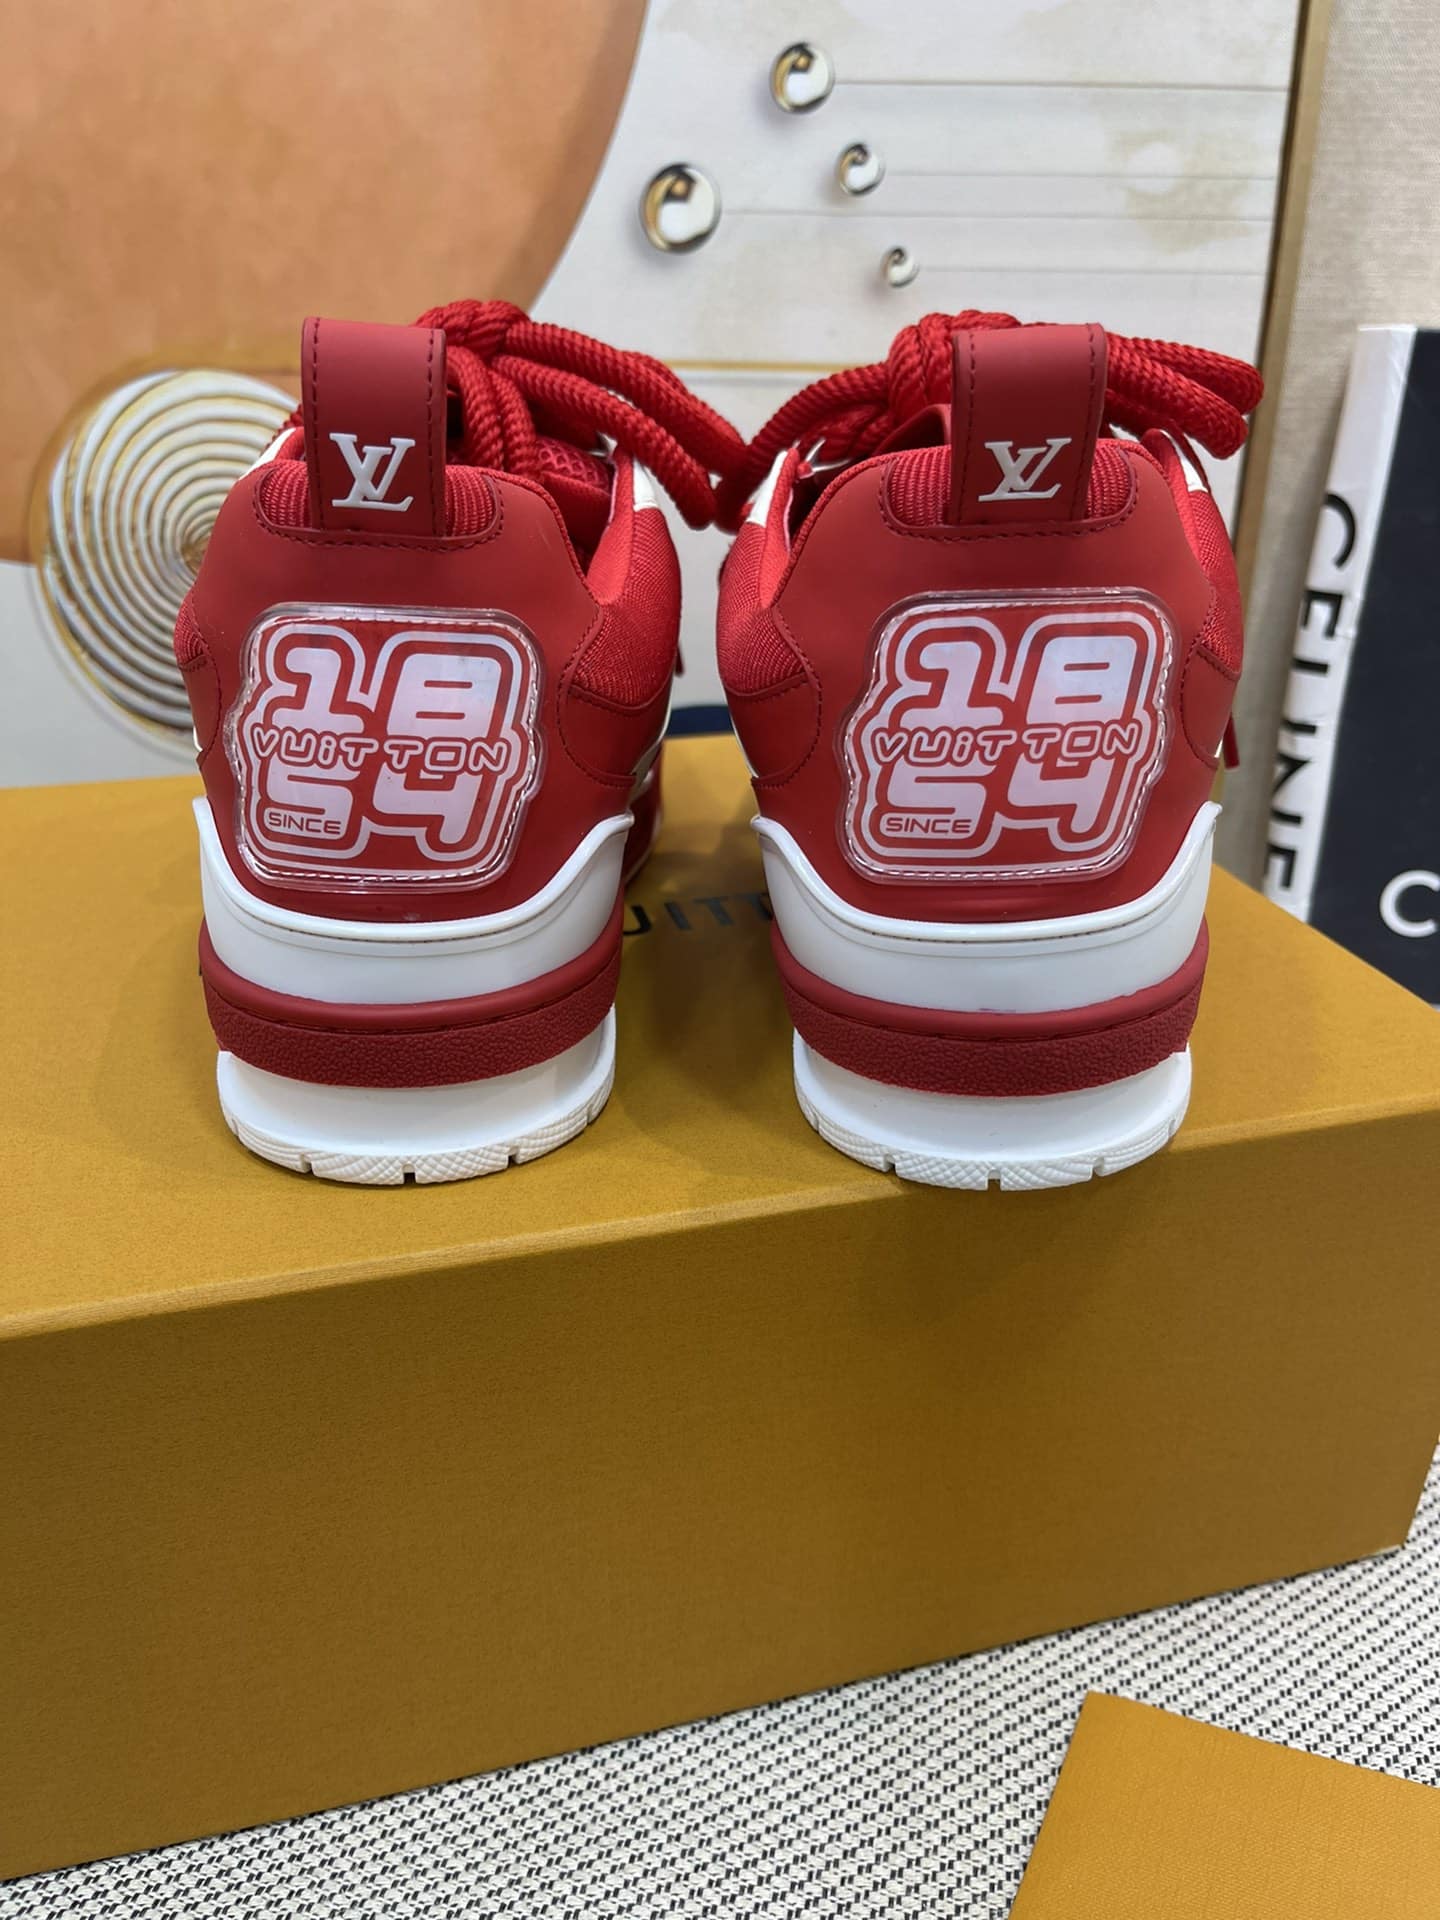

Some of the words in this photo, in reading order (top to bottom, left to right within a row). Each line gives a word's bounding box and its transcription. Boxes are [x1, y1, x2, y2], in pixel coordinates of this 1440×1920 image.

[329, 432, 416, 512] LV
[978, 437, 1072, 502] LV
[271, 646, 502, 737] 18
[899, 635, 1138, 727] 18
[266, 755, 484, 845] 54
[267, 811, 342, 835] SINCE
[884, 817, 972, 833] SINCE
[886, 752, 1116, 834] 54
